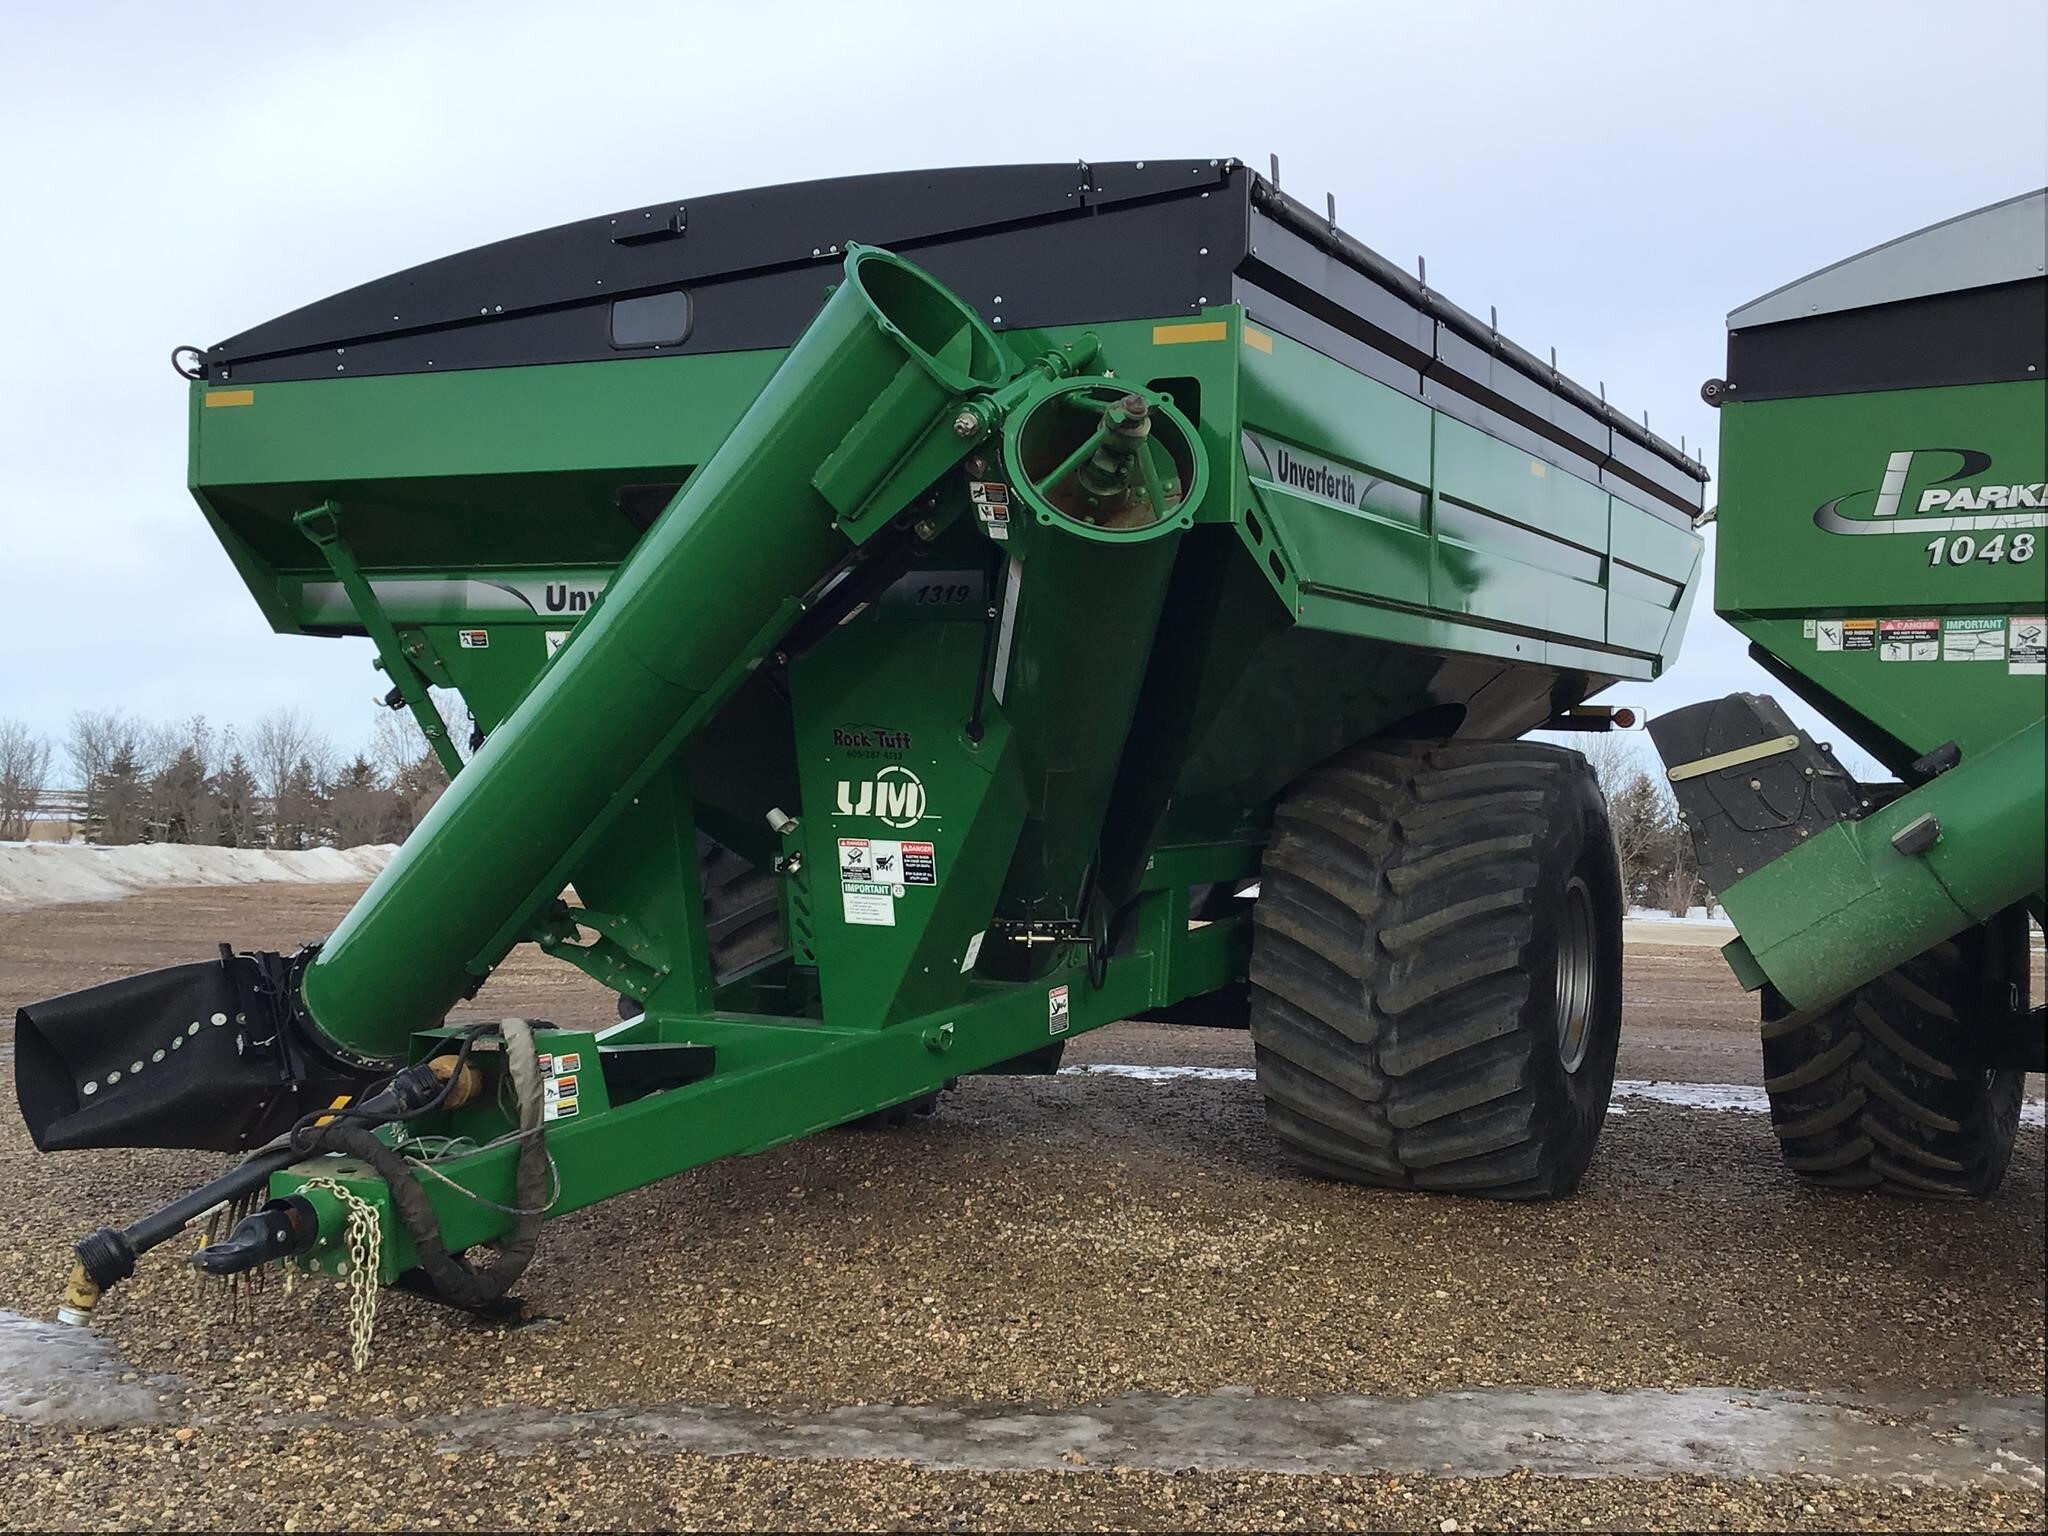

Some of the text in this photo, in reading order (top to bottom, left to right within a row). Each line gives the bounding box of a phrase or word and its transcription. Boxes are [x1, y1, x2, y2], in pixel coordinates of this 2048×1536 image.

[1277, 449, 1356, 505] Unverferth
[1925, 533, 2037, 567] 1048
[917, 584, 970, 604] 1319
[1946, 619, 2003, 630] IMPORTANT
[909, 845, 932, 853] DANGER
[845, 884, 889, 895] IMPORTANT
